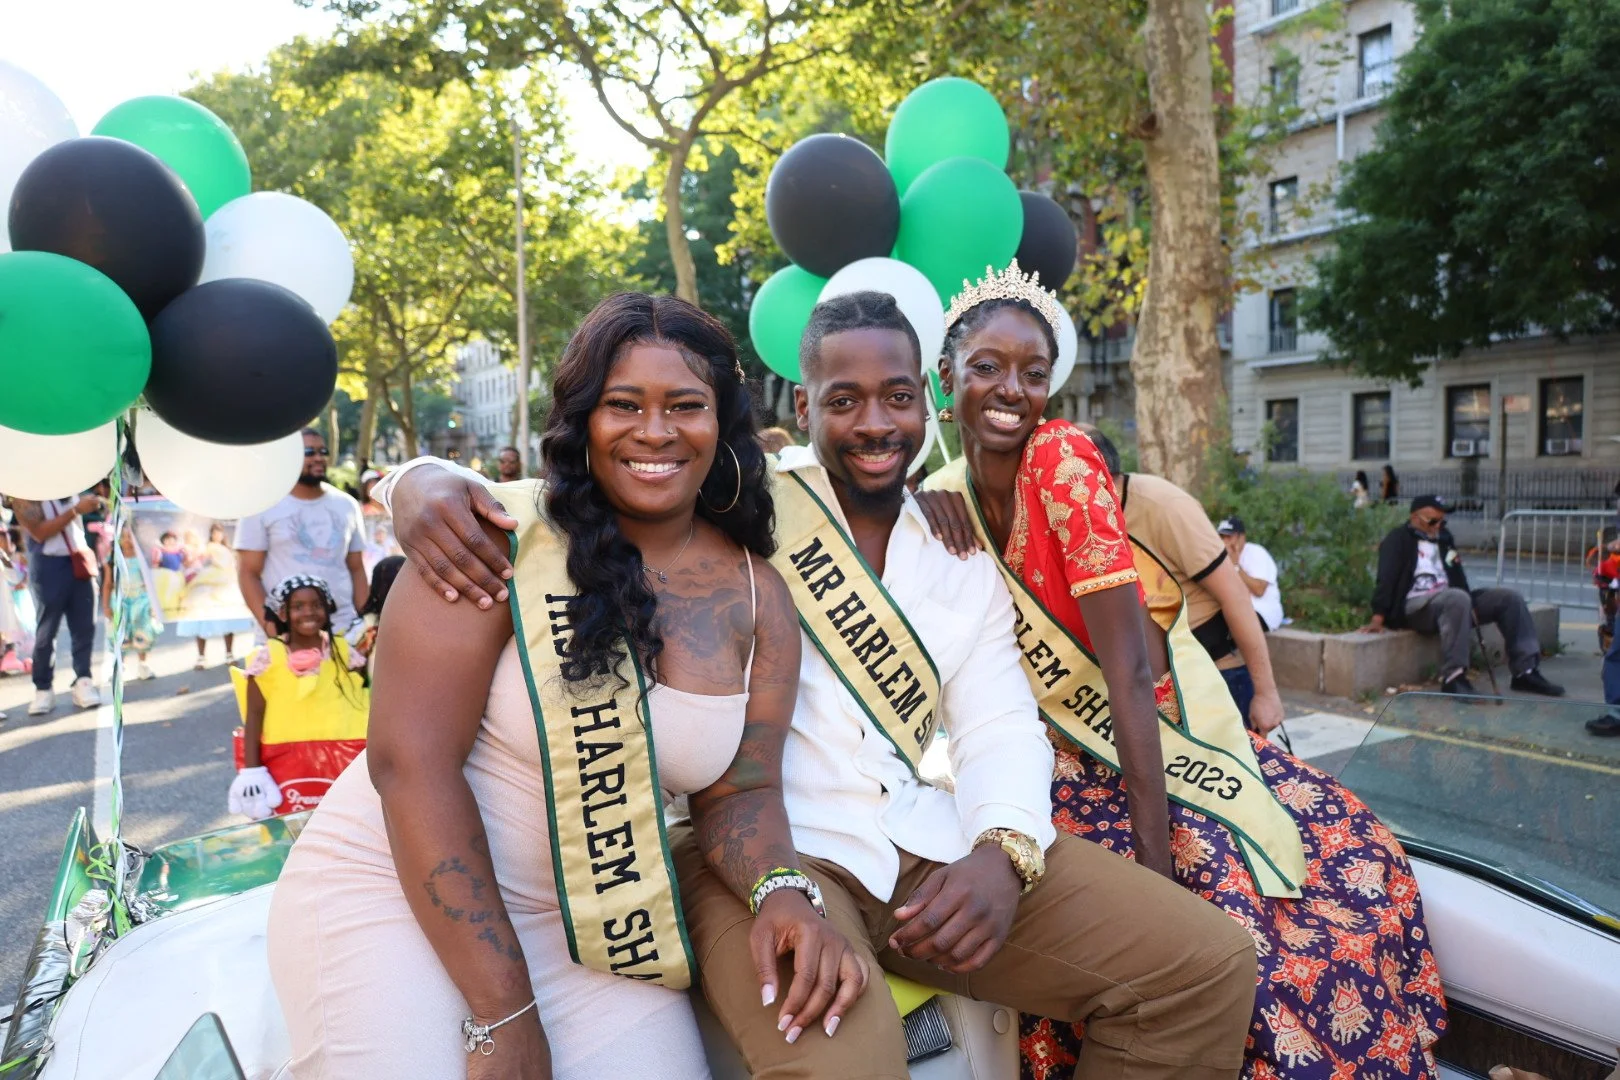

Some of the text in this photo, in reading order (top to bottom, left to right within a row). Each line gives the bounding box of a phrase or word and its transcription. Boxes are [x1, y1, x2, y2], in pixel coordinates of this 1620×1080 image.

[789, 537, 935, 748] MR HARLEM S
[571, 699, 641, 894] HARLEM
[1061, 685, 1117, 747] SHA
[1165, 755, 1242, 800] 2023
[603, 908, 663, 984] SHA
